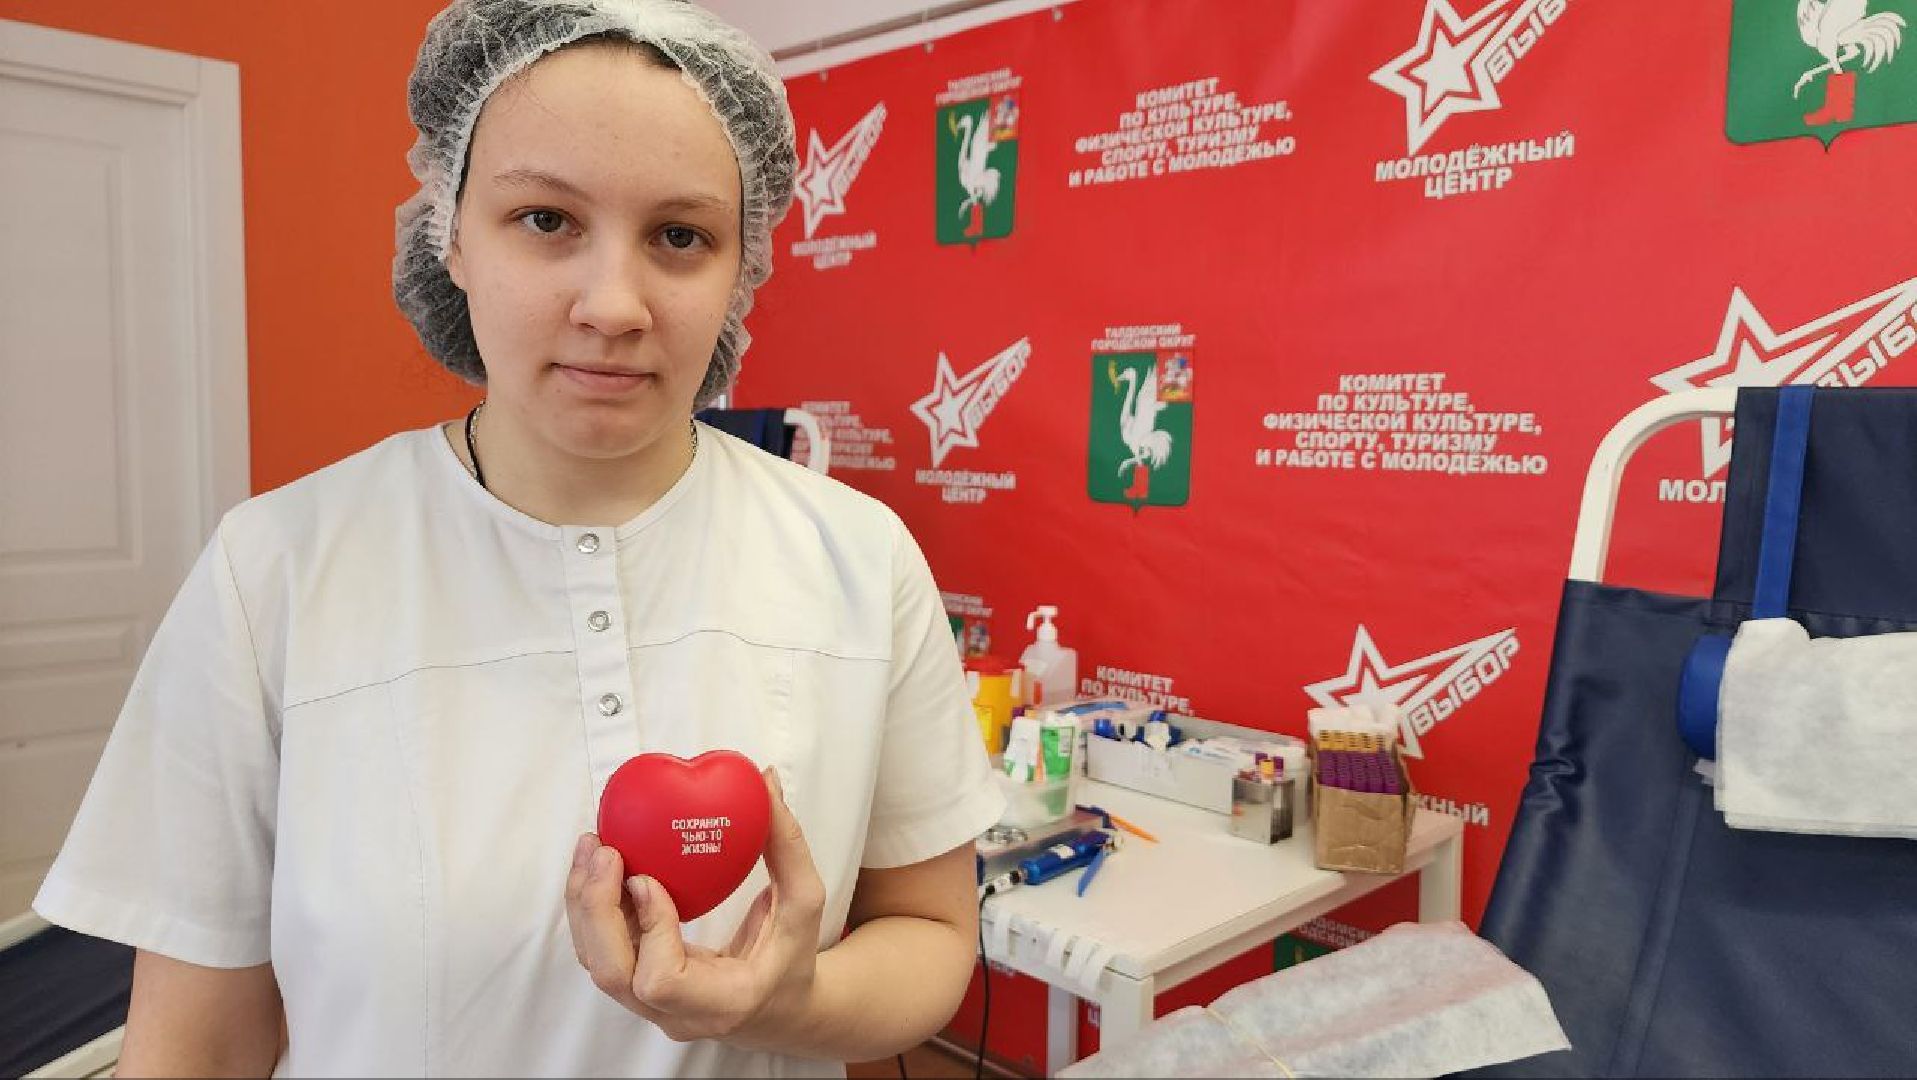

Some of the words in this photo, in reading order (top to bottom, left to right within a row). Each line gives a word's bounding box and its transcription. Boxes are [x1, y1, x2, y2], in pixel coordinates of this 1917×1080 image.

[1136, 77, 1219, 108] КОМИТЕТ
[1120, 111, 1145, 128] ПО
[1148, 92, 1241, 123] КУЛЬТУРЕ,
[1076, 121, 1188, 152] ФИЗИЧЕСКОЙ
[1193, 101, 1293, 133] КУЛЬТУРЕ,
[1102, 140, 1171, 165] СПОРТУ,
[1177, 125, 1259, 153] ТУРИЗМУ
[1376, 129, 1574, 182] МОЛОДЁЖНЫЙ
[1069, 170, 1081, 187] И
[1084, 161, 1148, 184] РАБОТЕ
[1153, 158, 1164, 175] С
[1169, 137, 1296, 172] МОЛОДЕЖЬЮ
[1425, 167, 1512, 199] ЦЕНТР
[1340, 373, 1445, 392] КОМИТЕТ
[1318, 394, 1347, 411] ПО
[1353, 393, 1474, 413] КУЛЬТУРЕ,
[1264, 412, 1406, 431] ФИЗИЧЕСКОЙ
[1413, 413, 1542, 435] КУЛЬТУРЕ,
[1296, 432, 1384, 452] СПОРТУ,
[1391, 433, 1497, 451] ТУРИЗМУ
[1256, 450, 1270, 465] И
[1276, 450, 1355, 468] РАБОТЕ
[1361, 453, 1375, 468] С
[1382, 453, 1548, 475] МОЛОДЕЖЬЮ
[1081, 678, 1103, 695] ПО
[1097, 665, 1174, 692] КОМИТЕТ
[1409, 636, 1520, 737] ВЫБОР
[672, 816, 730, 830] СОХРАНИТЬ
[681, 829, 722, 842] ЧЬЮ-ТО
